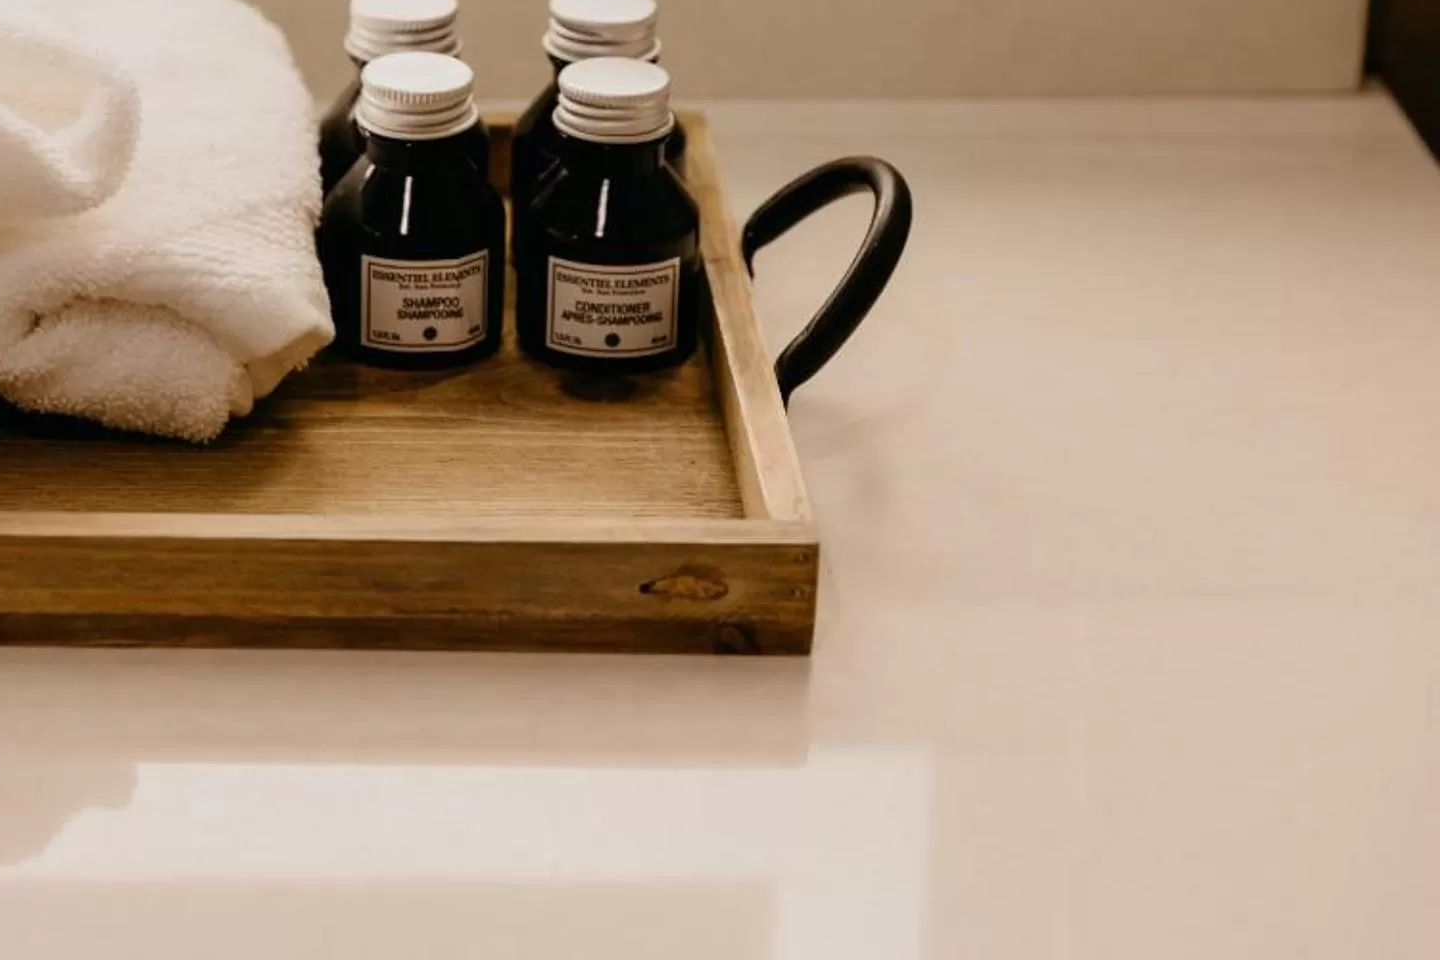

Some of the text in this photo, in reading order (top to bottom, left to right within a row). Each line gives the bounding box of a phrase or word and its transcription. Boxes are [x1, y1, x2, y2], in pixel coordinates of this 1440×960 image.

[431, 264, 481, 283] ELEMENTS
[614, 274, 670, 289] ELEMENTS
[402, 296, 460, 308] SHAMPOO
[575, 300, 650, 314] CONDITIONER
